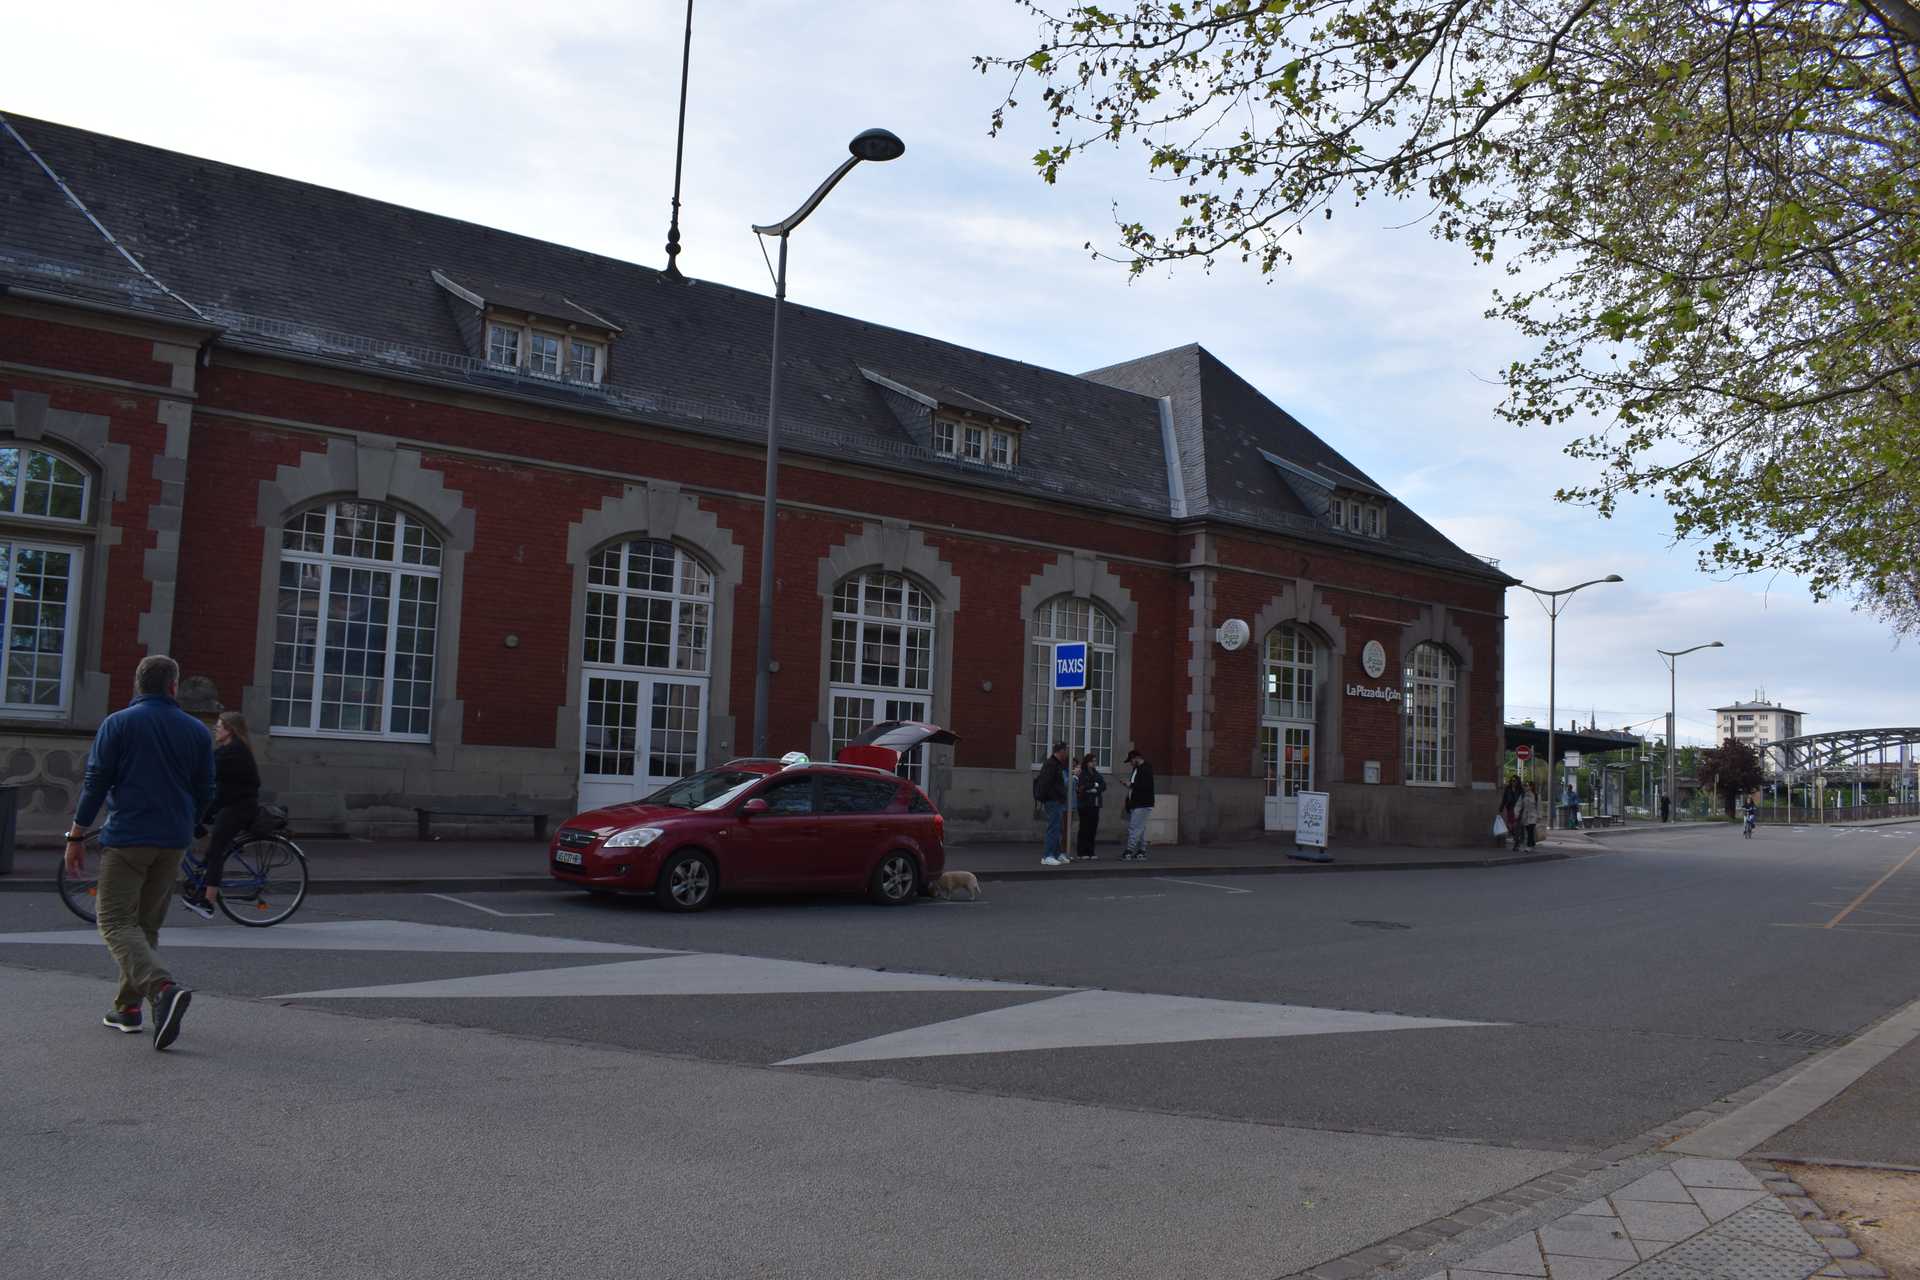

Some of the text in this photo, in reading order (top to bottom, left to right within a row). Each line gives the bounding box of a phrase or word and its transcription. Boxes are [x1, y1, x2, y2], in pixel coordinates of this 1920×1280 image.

[1057, 658, 1084, 674] TAXIS
[1346, 684, 1356, 696] La
[1356, 685, 1375, 698] Pizza
[1375, 687, 1385, 698] du
